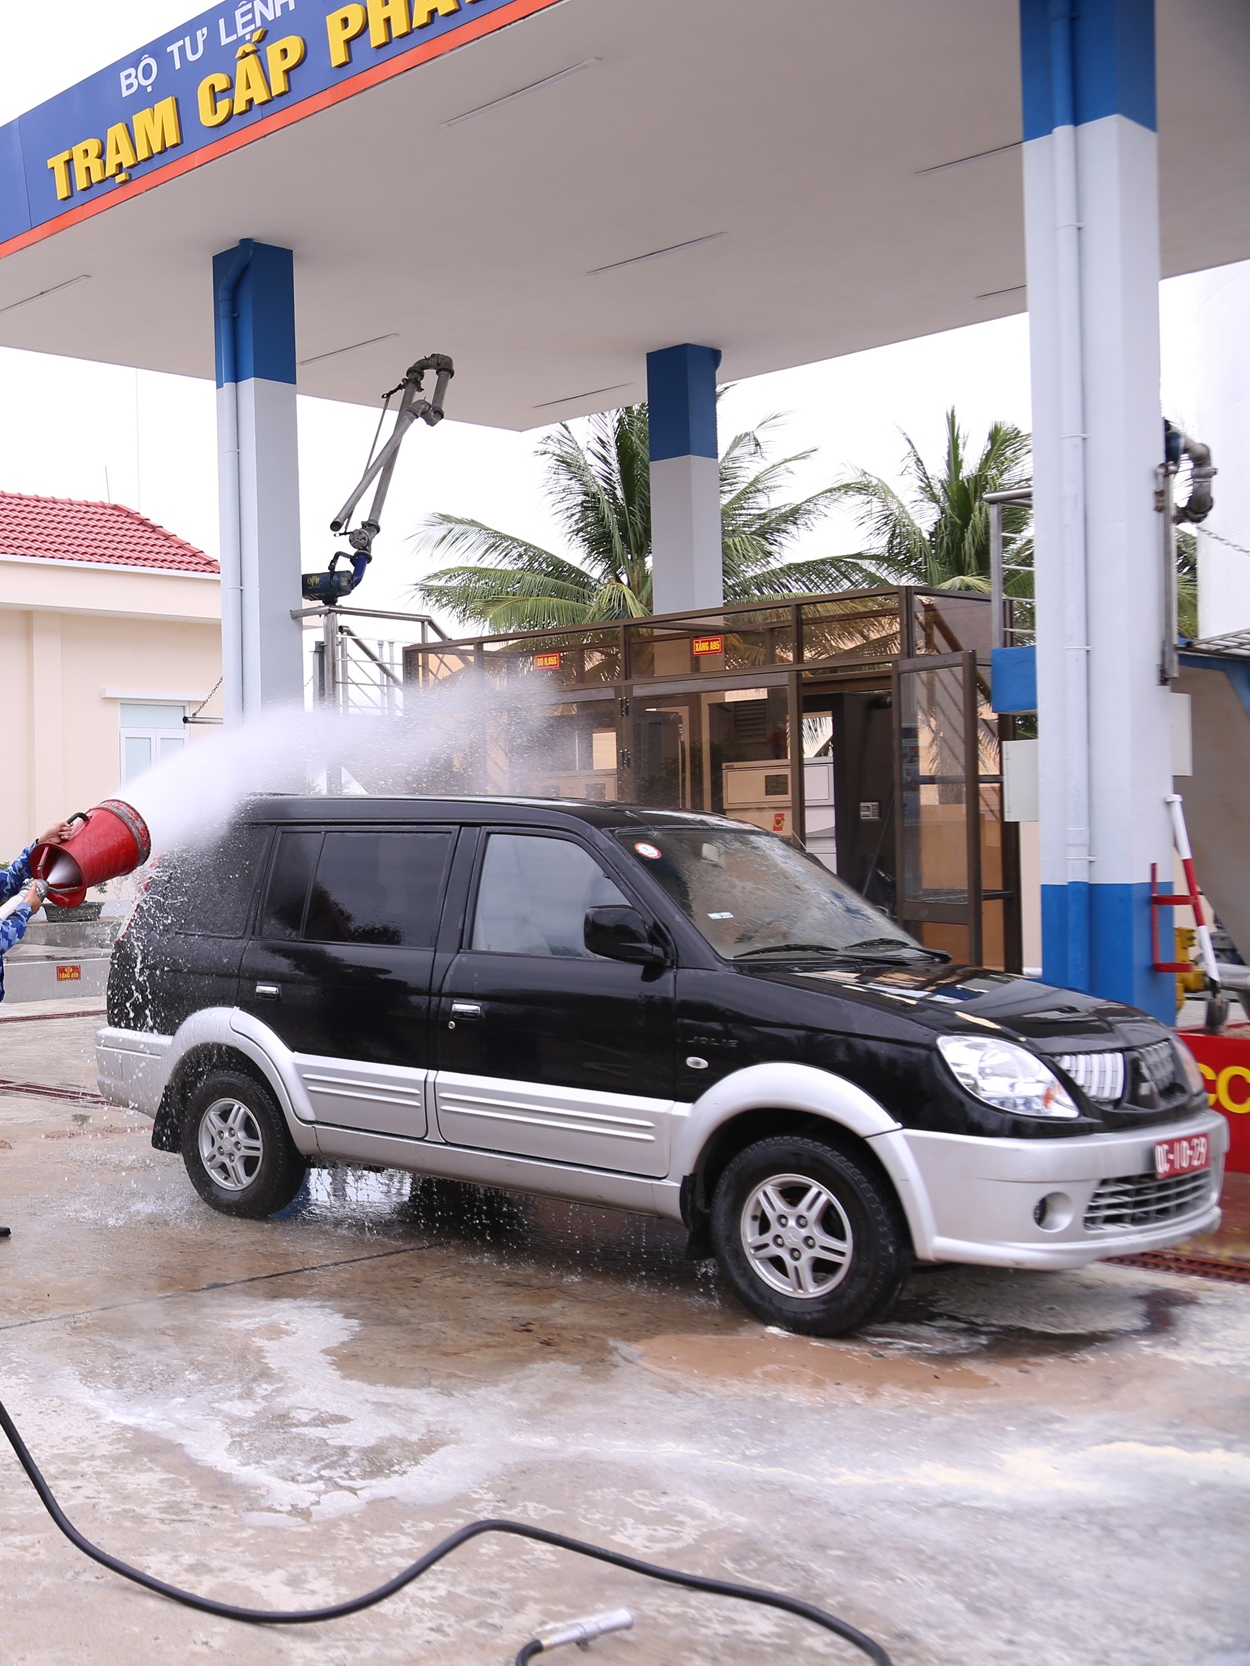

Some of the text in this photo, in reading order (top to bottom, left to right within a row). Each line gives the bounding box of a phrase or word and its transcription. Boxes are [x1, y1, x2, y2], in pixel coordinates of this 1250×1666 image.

[46, 96, 182, 202] TRẠM
[196, 28, 306, 127] CẤP
[119, 54, 158, 98] BỘ
[166, 26, 208, 71] TƯ
